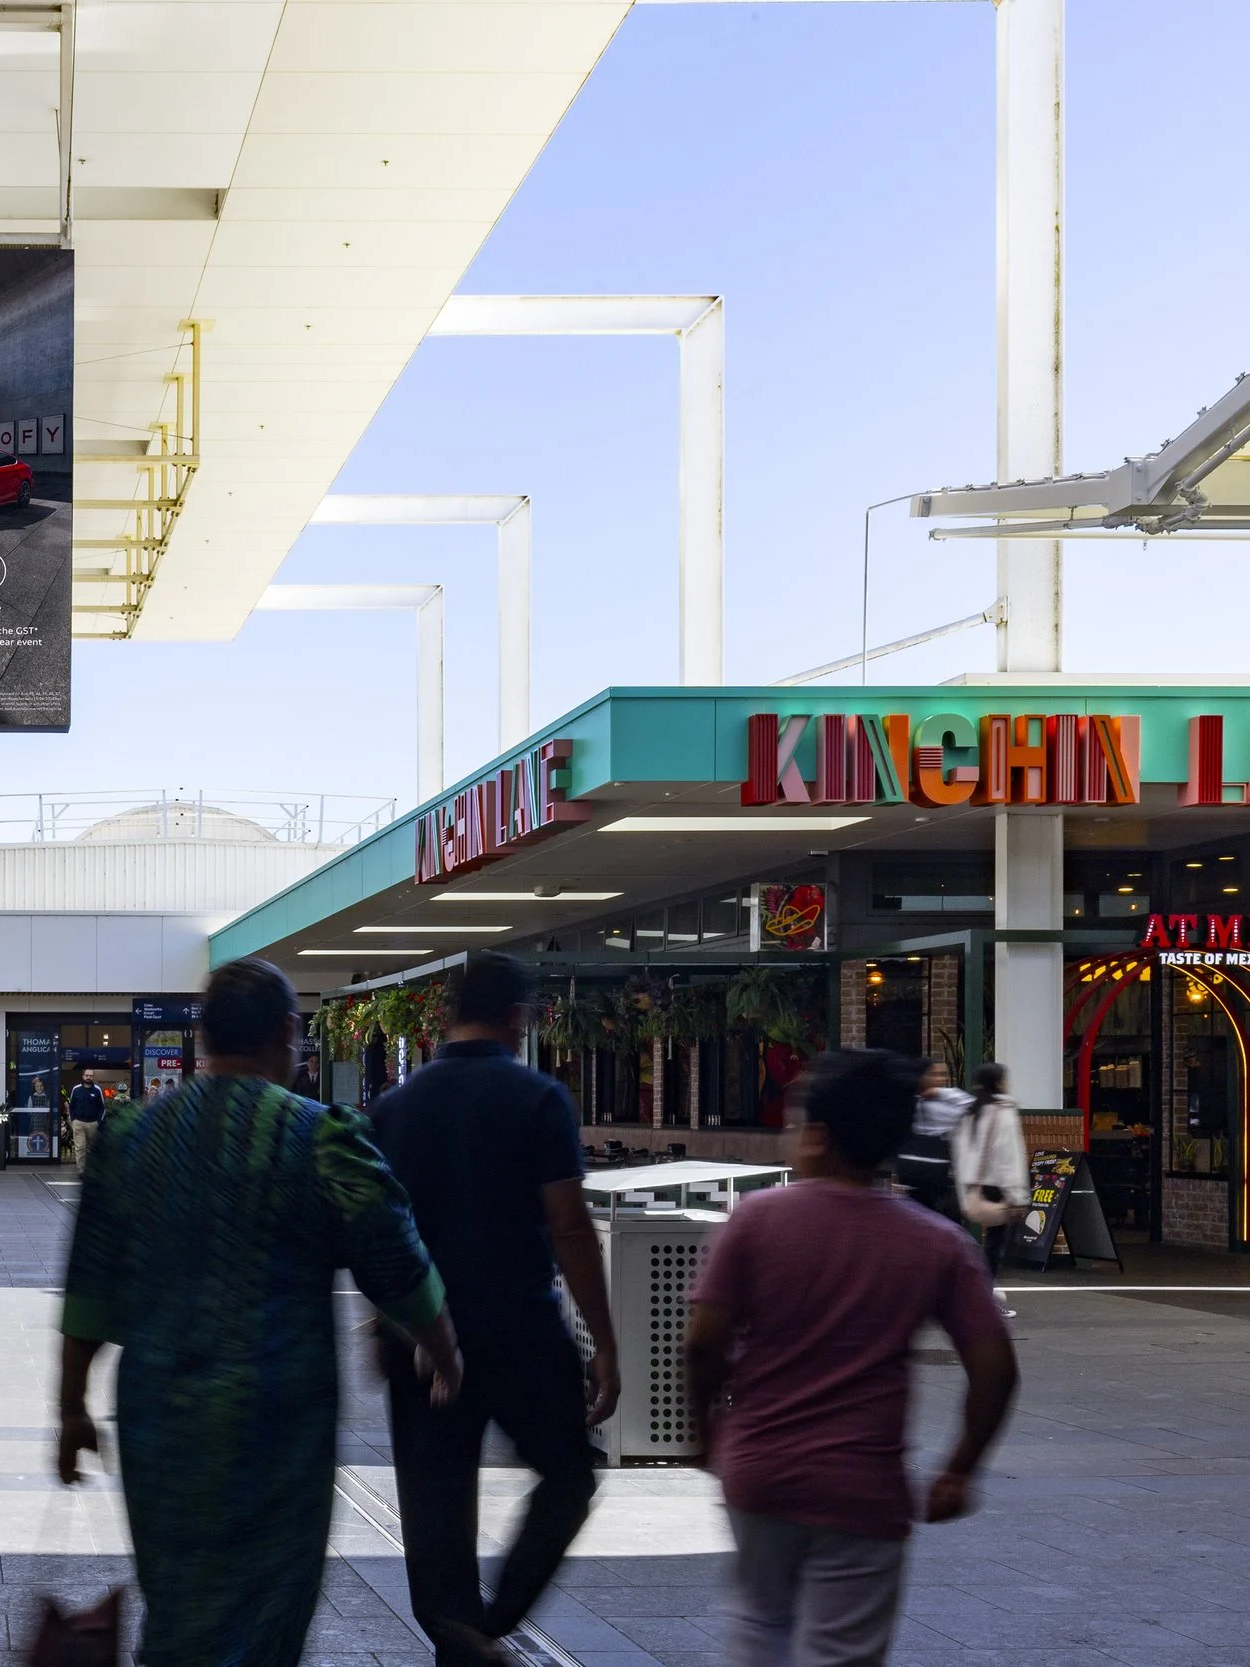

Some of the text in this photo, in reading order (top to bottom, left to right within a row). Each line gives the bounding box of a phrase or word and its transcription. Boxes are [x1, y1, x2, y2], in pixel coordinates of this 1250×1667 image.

[16, 638, 43, 647] event
[745, 713, 1141, 807] KINCHIN
[415, 739, 574, 885] KINCHIN LANE
[1159, 952, 1201, 965] TASTE
[1204, 952, 1223, 965] OF
[144, 1048, 179, 1056] DISCOVER
[1032, 1189, 1055, 1203] FREE
